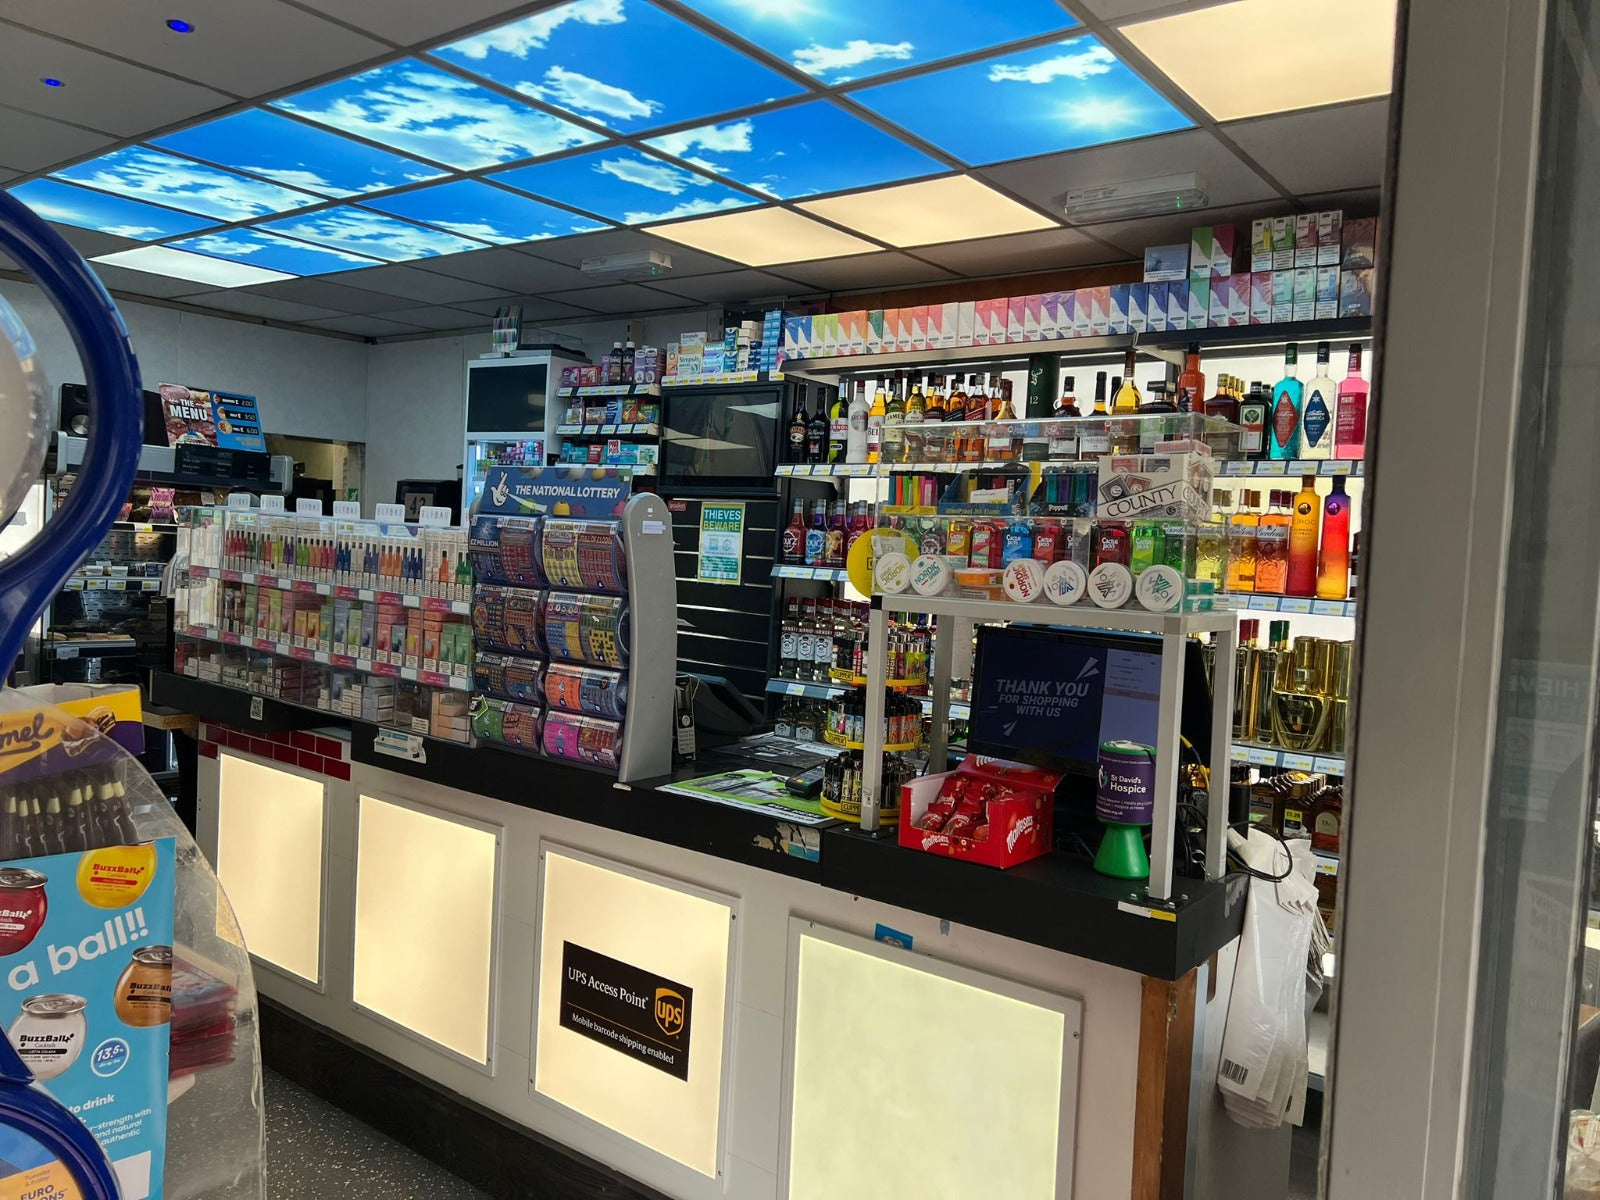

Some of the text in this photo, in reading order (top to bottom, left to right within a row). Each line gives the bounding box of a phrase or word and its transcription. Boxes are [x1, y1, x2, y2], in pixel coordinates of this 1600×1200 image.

[180, 399, 195, 408] THE
[1030, 396, 1039, 405] 12
[170, 405, 208, 421] MENU
[516, 484, 620, 498] THE NATIONAL LOTTERY
[1106, 484, 1178, 518] COUNTY
[704, 509, 740, 520] THIEVES
[704, 520, 740, 531] BEWARE
[914, 561, 939, 585] NORDIC
[996, 679, 1090, 697] THANK YOU
[1000, 694, 1078, 708] FOR SHOPPING
[1016, 704, 1062, 718] WITH US
[0, 712, 54, 750] mel
[1110, 782, 1146, 794] Hospice
[1118, 776, 1142, 784] David's
[8, 907, 149, 991] a ball!!
[130, 982, 172, 992] BuzzBall
[568, 966, 587, 985] UPS
[588, 976, 618, 998] Access
[657, 1000, 682, 1028] ups
[572, 1012, 674, 1064] Mobile barcode shipping enabled
[83, 1094, 116, 1110] drink
[90, 1108, 152, 1130] r-strength with
[112, 1120, 142, 1134] natural
[100, 1129, 141, 1146] authentic
[20, 1184, 54, 1200] EURO
